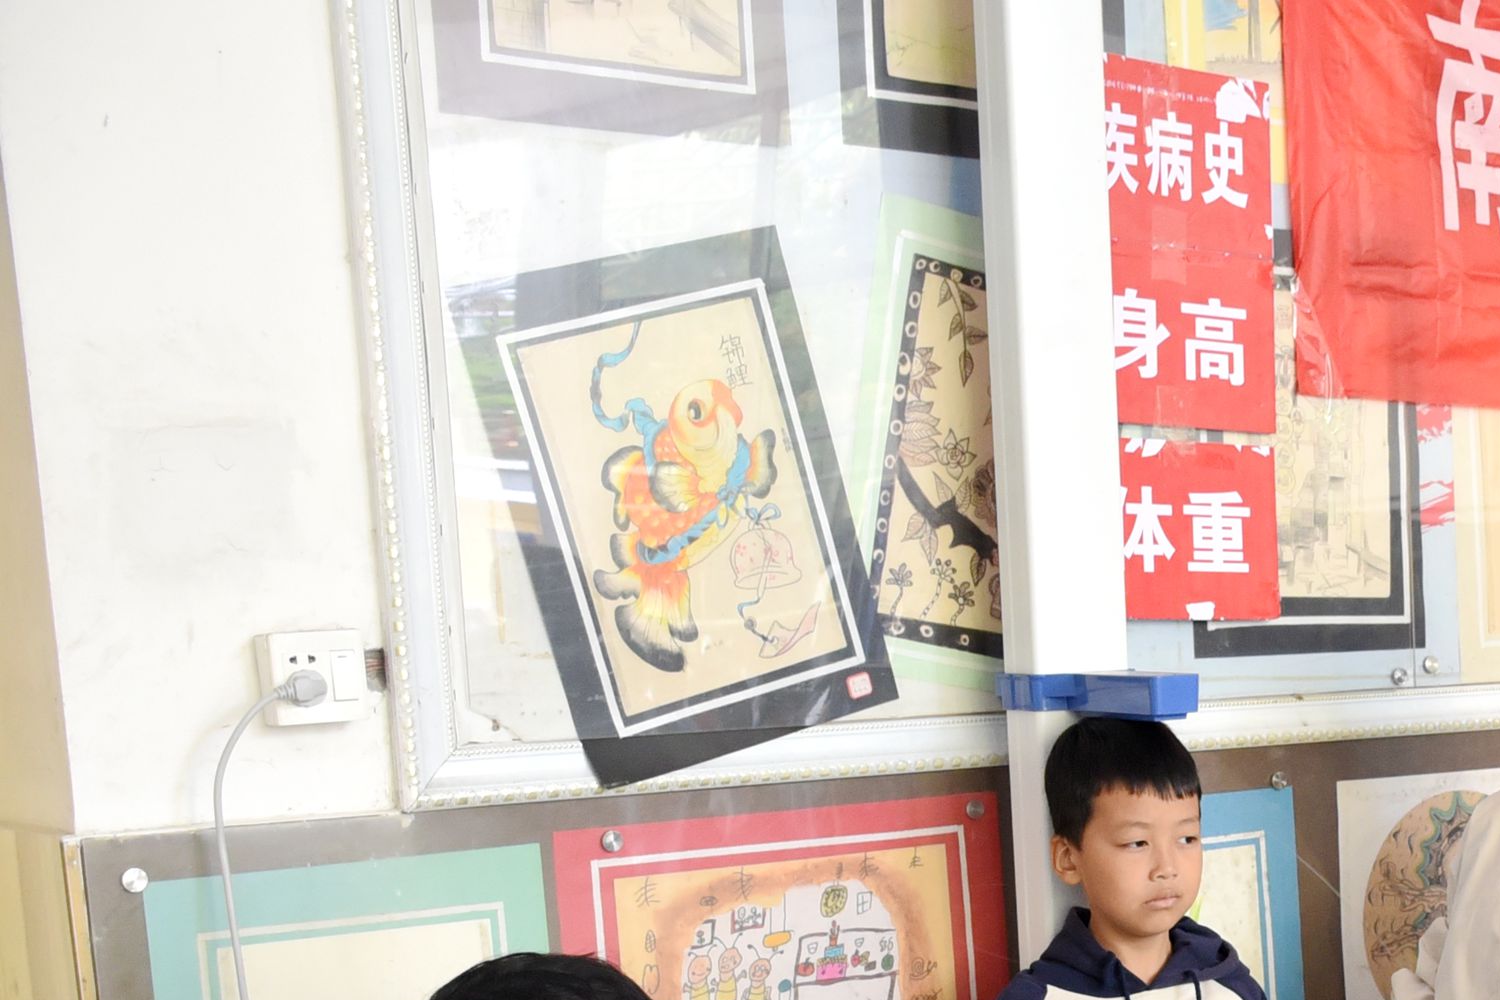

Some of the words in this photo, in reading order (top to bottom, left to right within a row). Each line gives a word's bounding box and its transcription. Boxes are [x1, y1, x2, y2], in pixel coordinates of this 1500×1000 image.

[1104, 103, 1249, 209] 疾病史
[1112, 288, 1247, 387] 身高
[1121, 486, 1251, 573] 体重
